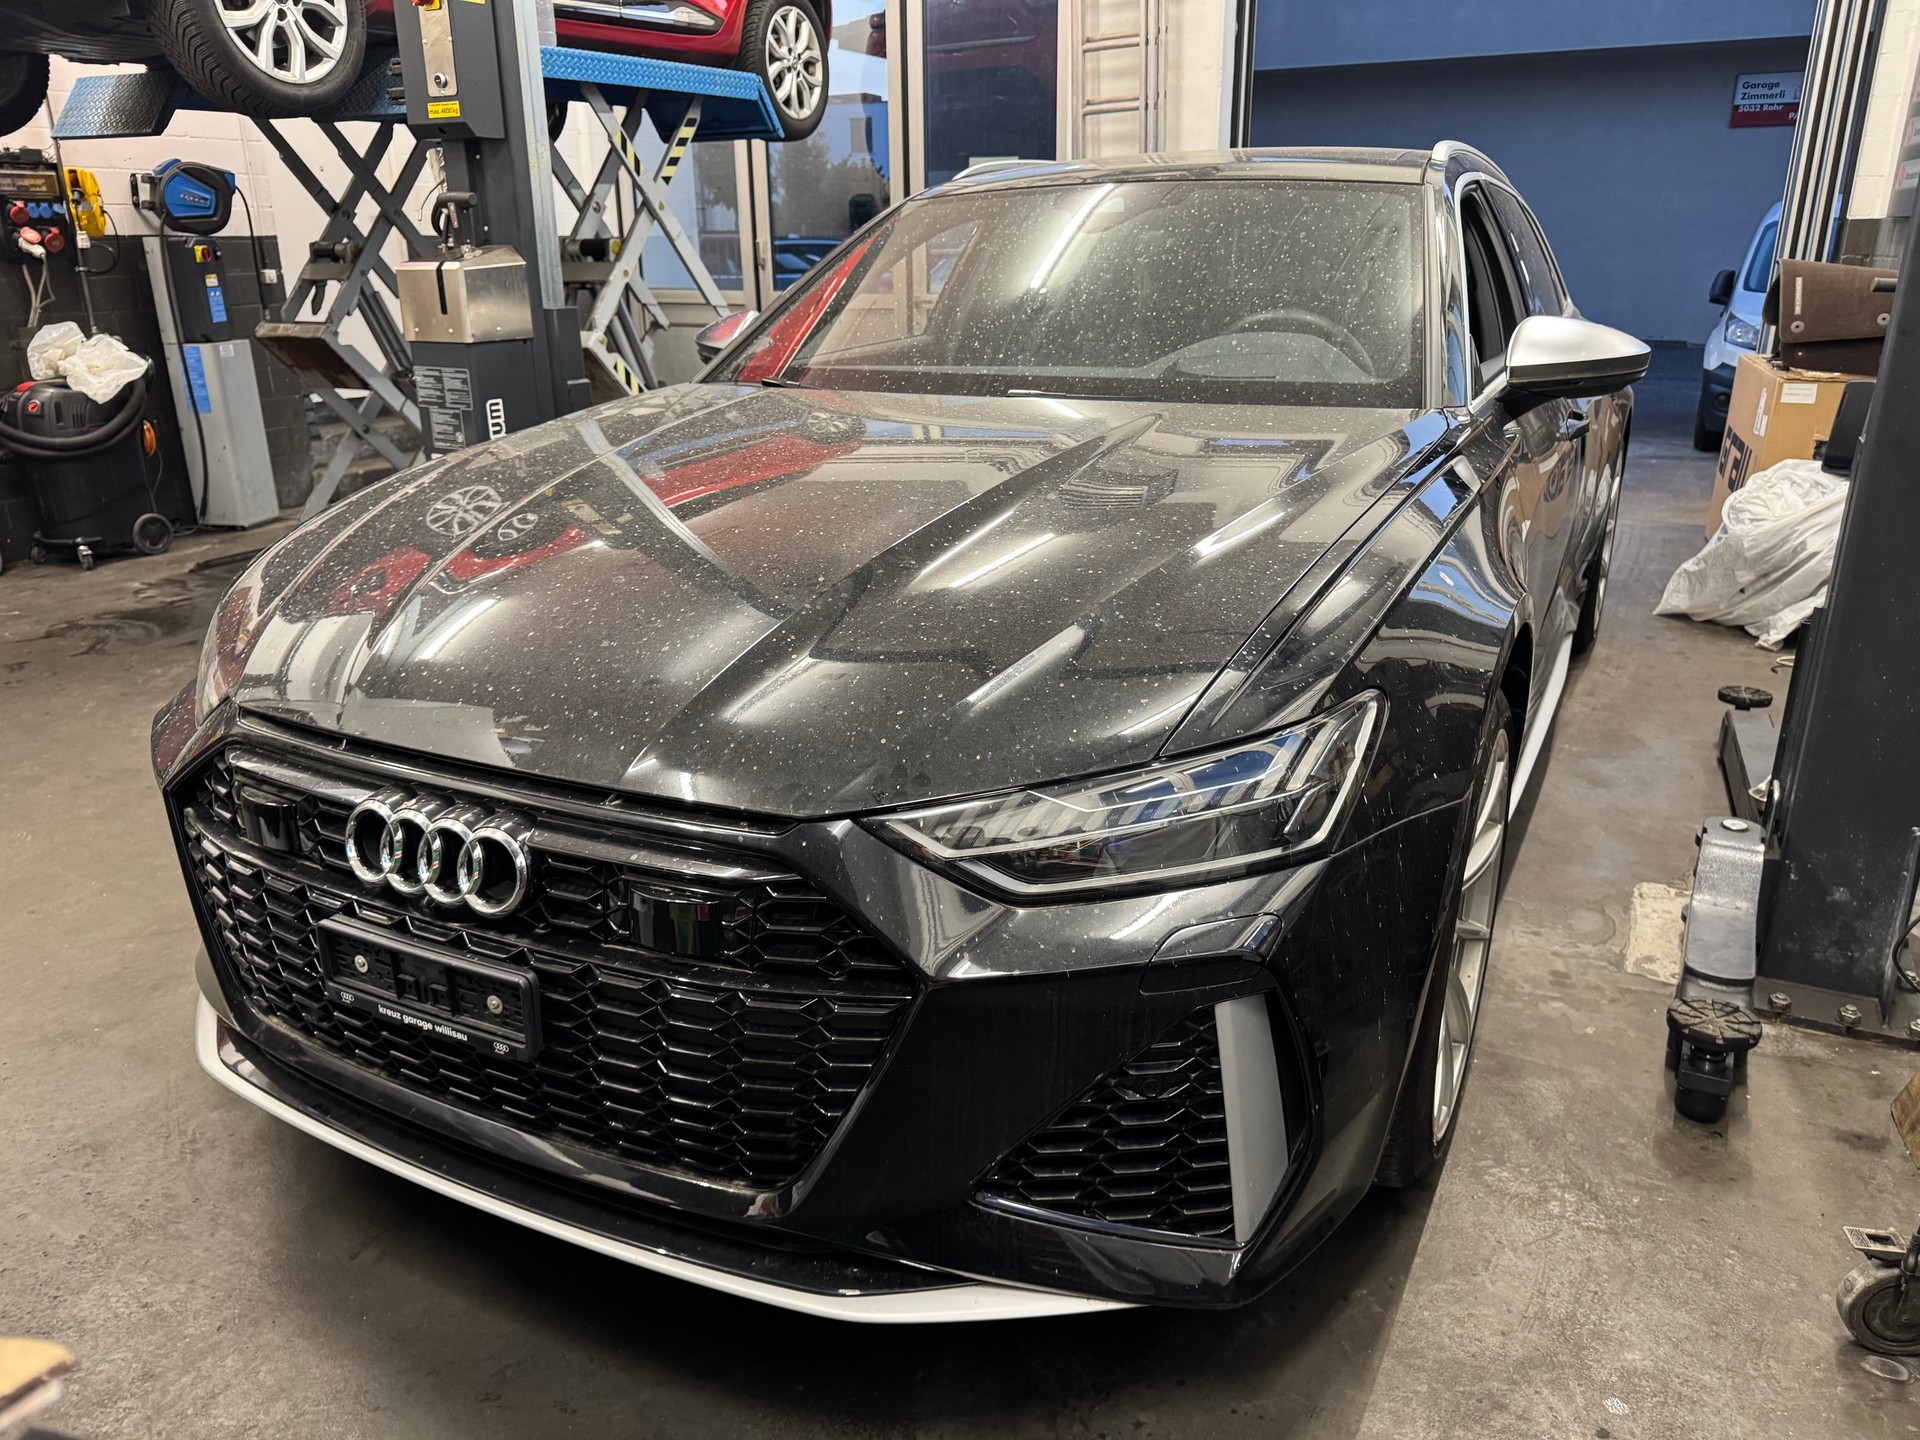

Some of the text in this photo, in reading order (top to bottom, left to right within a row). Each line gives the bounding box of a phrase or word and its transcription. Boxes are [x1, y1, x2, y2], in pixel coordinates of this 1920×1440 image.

[1742, 81, 1780, 90] Garage
[1740, 90, 1786, 100] Zimmerli
[1738, 104, 1760, 112] 5032
[378, 1004, 468, 1041] kreuz garage willisau
